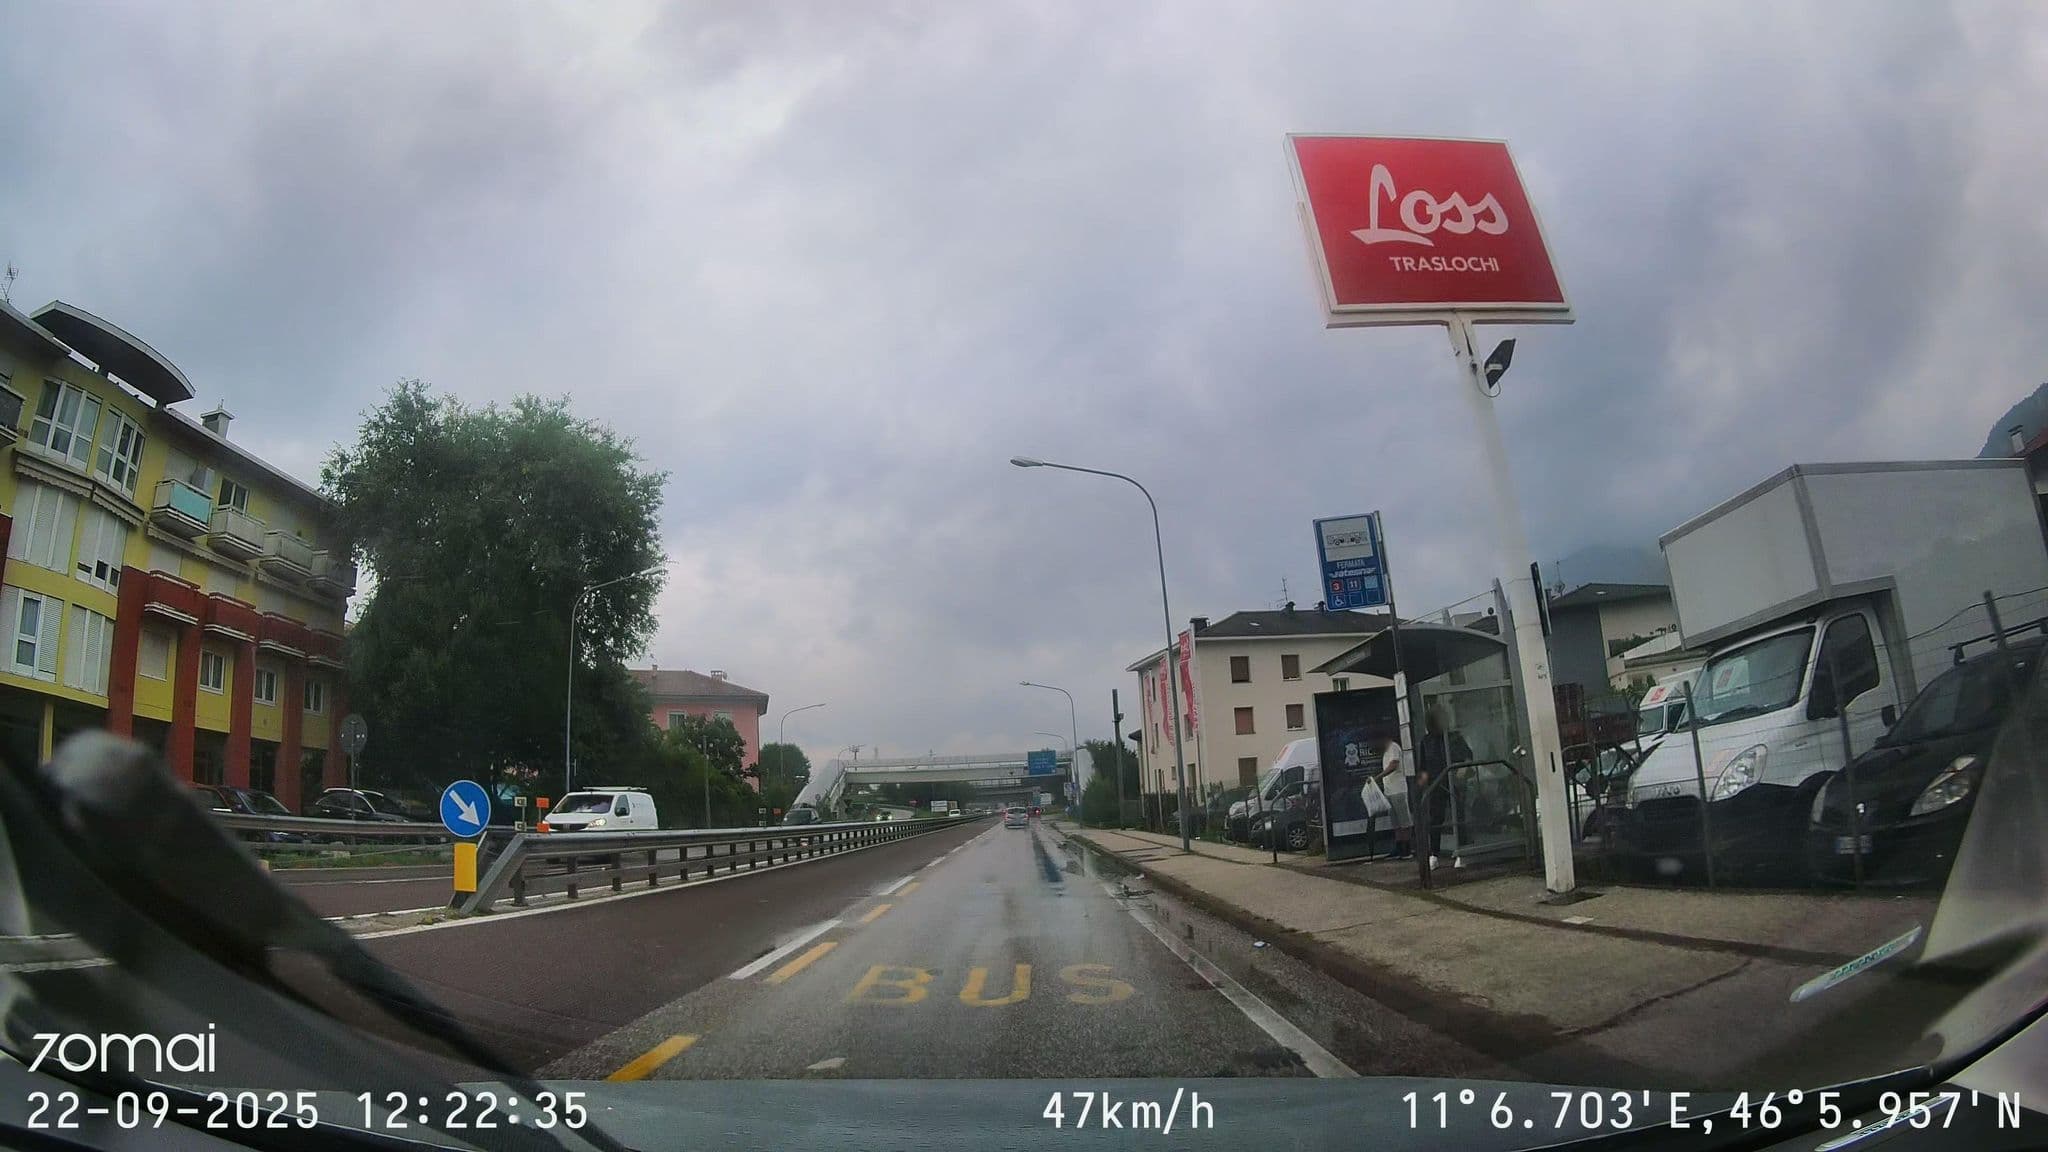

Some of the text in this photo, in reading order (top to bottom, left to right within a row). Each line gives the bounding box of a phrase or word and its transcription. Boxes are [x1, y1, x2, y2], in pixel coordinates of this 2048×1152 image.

[1350, 163, 1509, 247] Loss
[1389, 256, 1500, 272] TRASLOCHI
[848, 963, 1135, 1007] BUS
